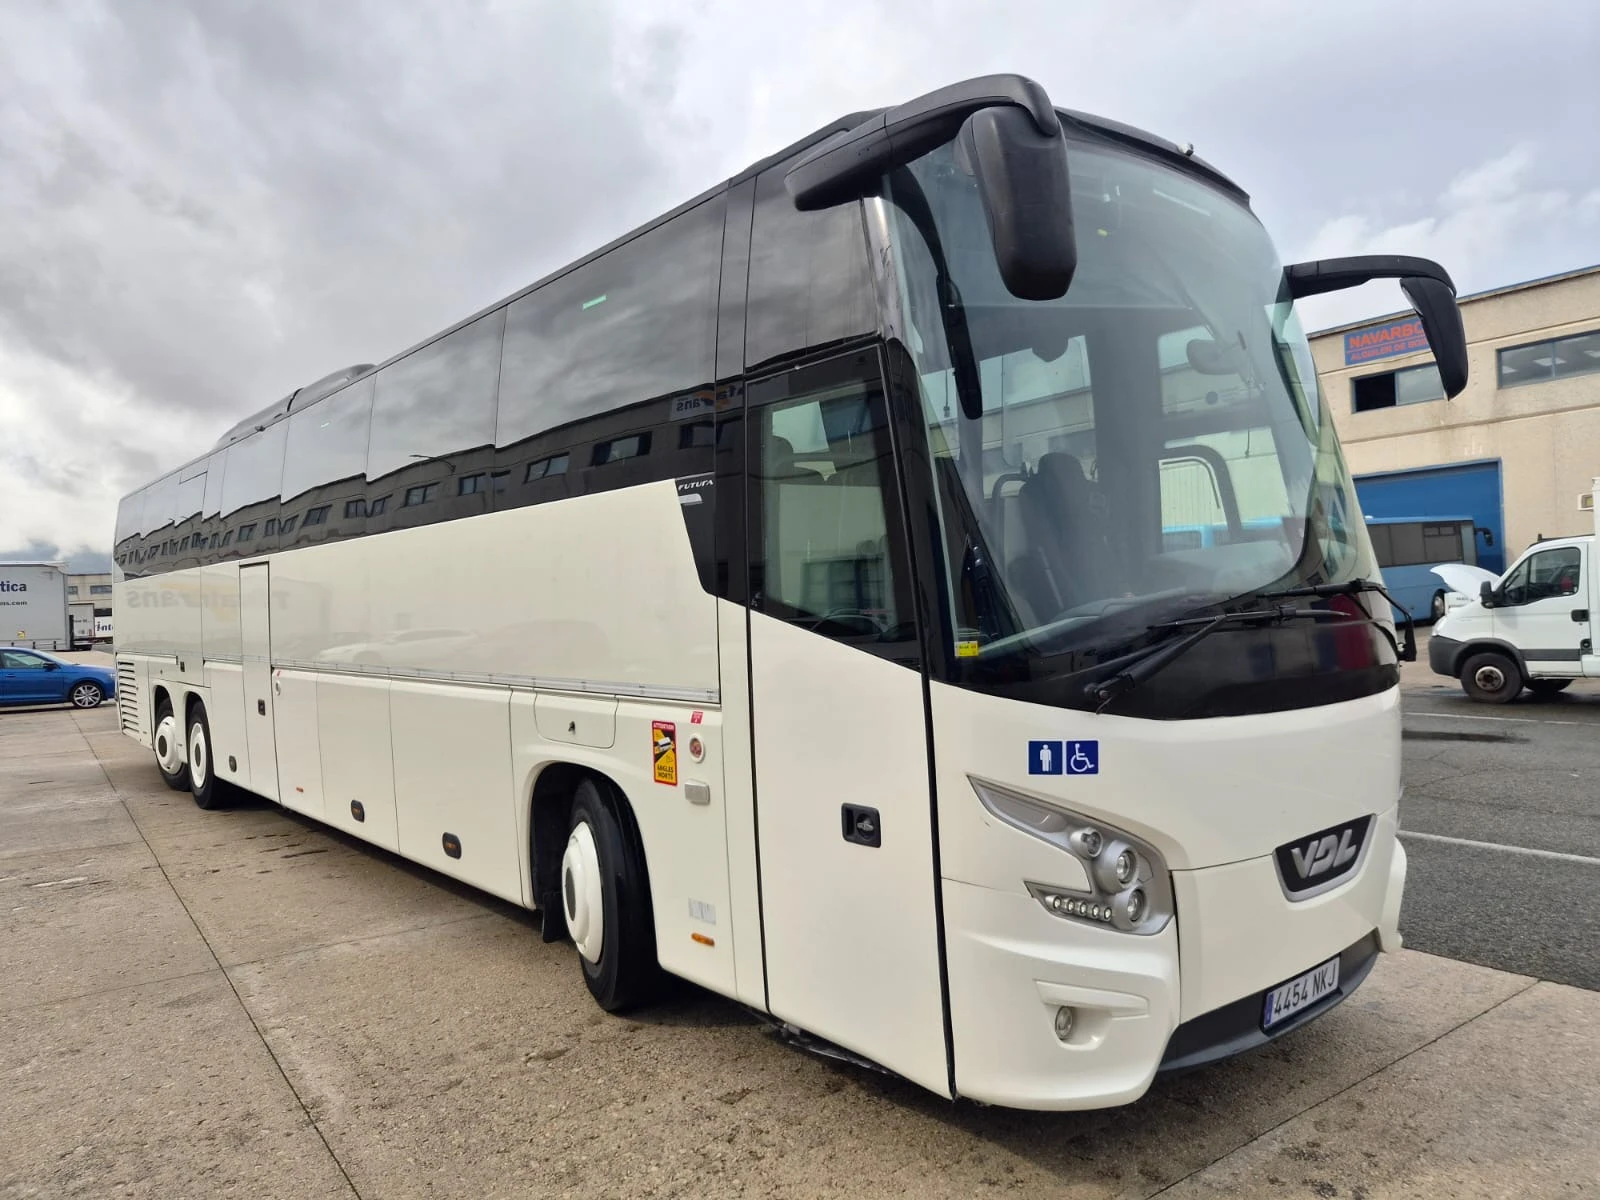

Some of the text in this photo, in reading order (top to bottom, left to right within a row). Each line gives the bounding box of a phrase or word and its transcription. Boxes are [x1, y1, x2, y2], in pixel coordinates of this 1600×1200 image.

[678, 479, 714, 490] FUTURA
[1290, 829, 1357, 879] VDL
[1274, 964, 1337, 1015] 4454 NKJ
